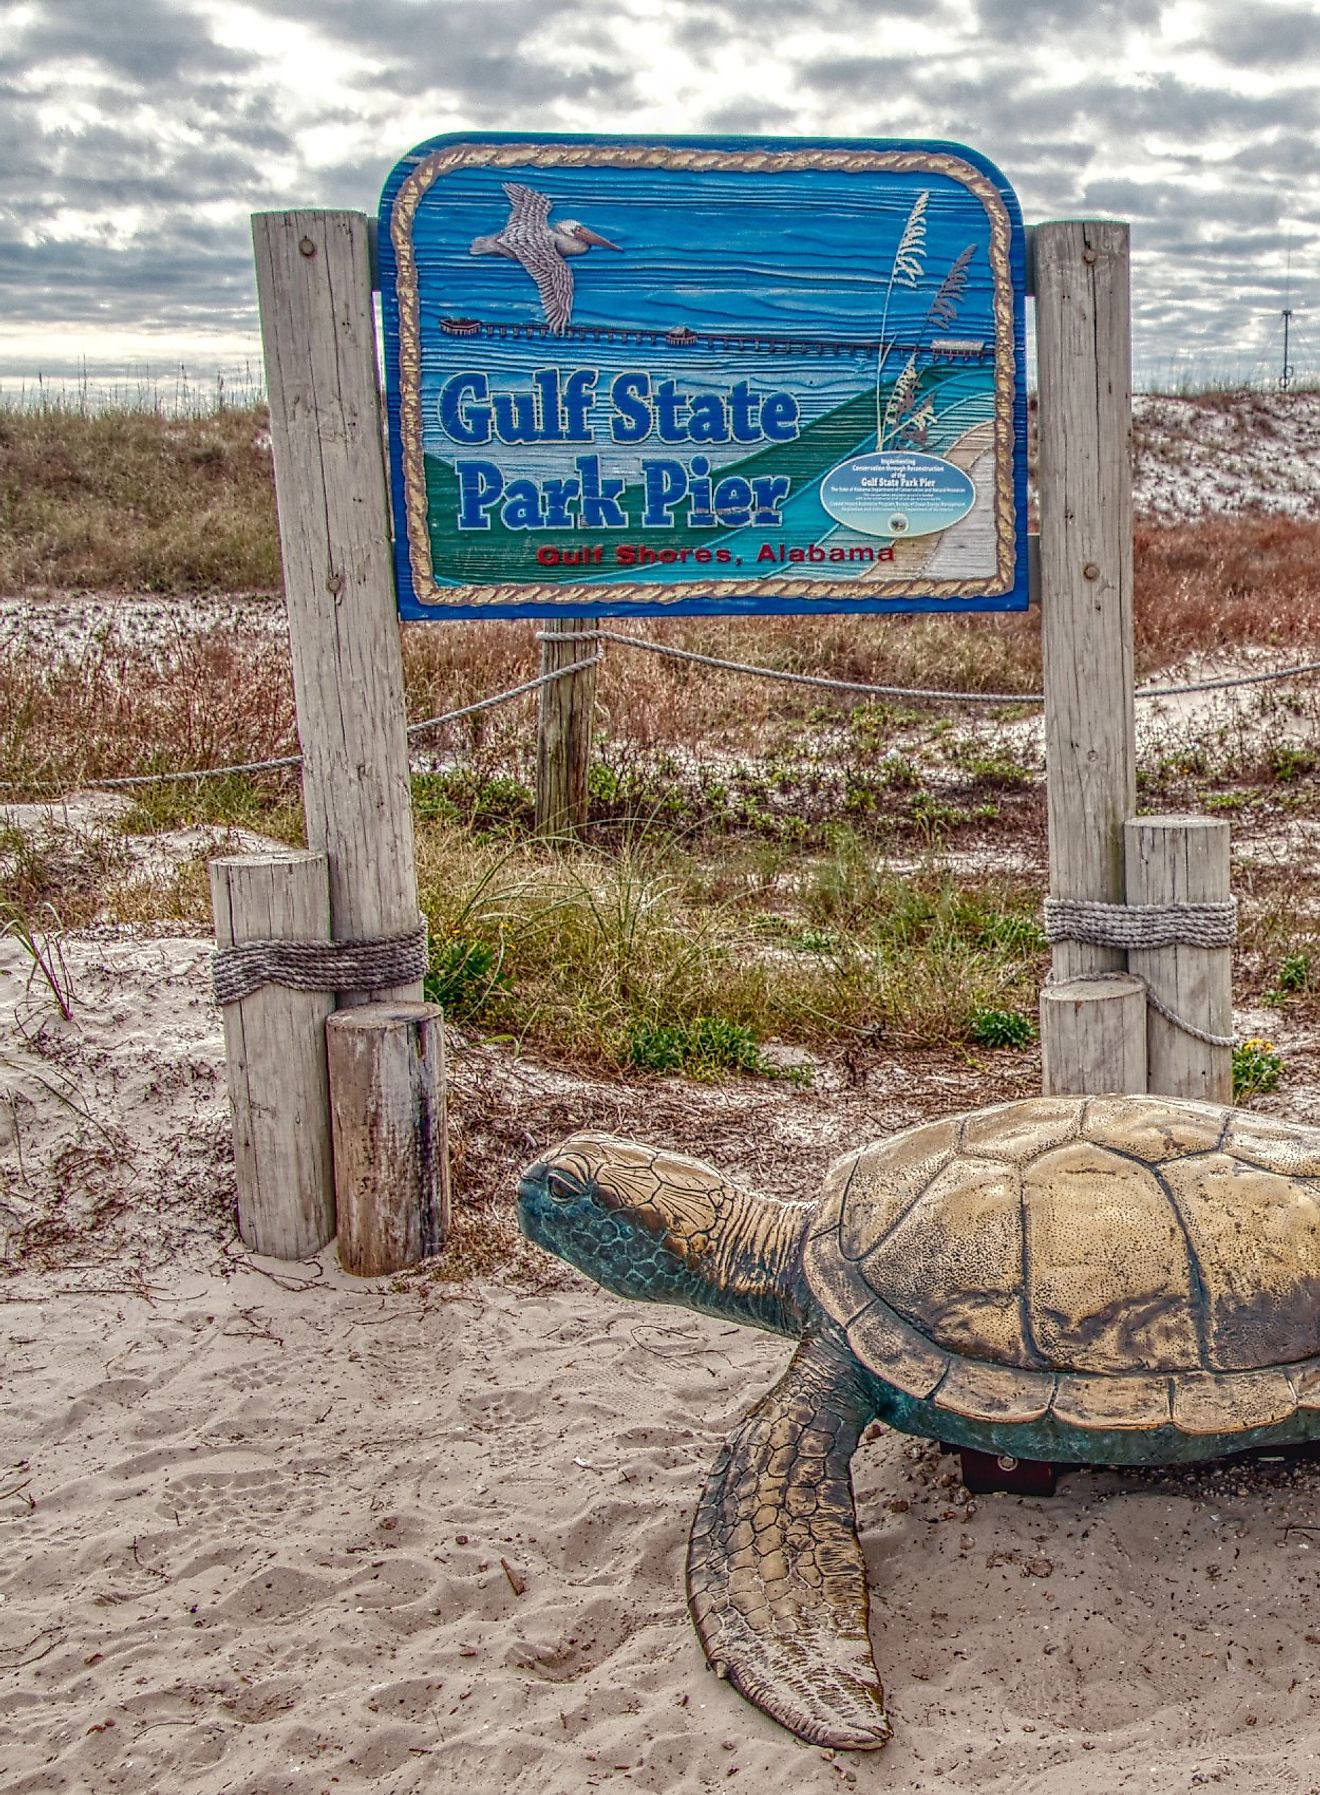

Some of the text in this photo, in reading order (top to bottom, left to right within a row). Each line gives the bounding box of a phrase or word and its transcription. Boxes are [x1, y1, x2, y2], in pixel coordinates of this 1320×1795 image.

[437, 366, 801, 445] Gulf State
[454, 454, 791, 530] Park Pier
[861, 477, 936, 487] Gulf State Park Pier
[536, 543, 895, 567] Gulf Shores, Alabama
